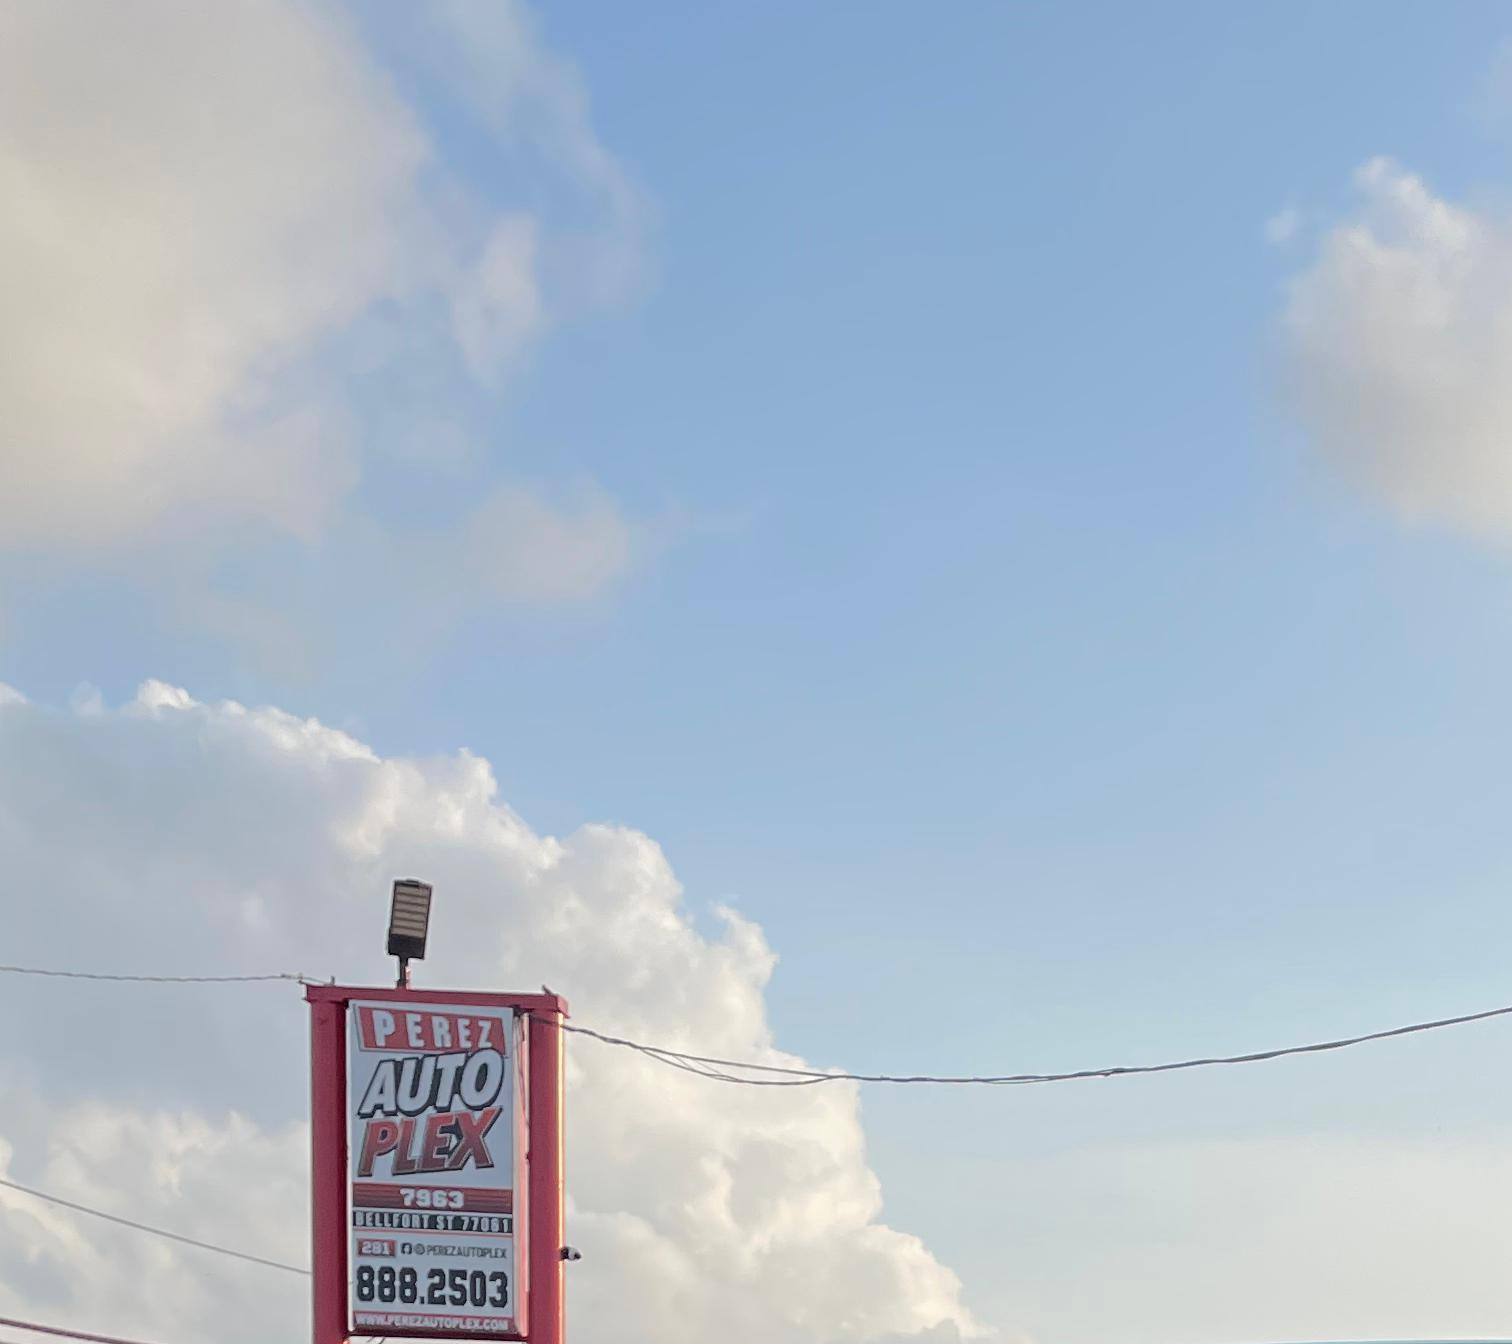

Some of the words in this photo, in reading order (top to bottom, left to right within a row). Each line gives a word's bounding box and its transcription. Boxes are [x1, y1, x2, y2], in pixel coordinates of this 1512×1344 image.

[372, 1010, 493, 1049] PEREZ
[357, 1047, 505, 1118] AUTO
[357, 1106, 502, 1177] PLEX
[400, 1187, 465, 1209] 7963
[355, 1211, 429, 1229] BELLFORT
[436, 1215, 454, 1230] ST
[361, 1241, 391, 1255] 281
[357, 1265, 508, 1308] 888.2503
